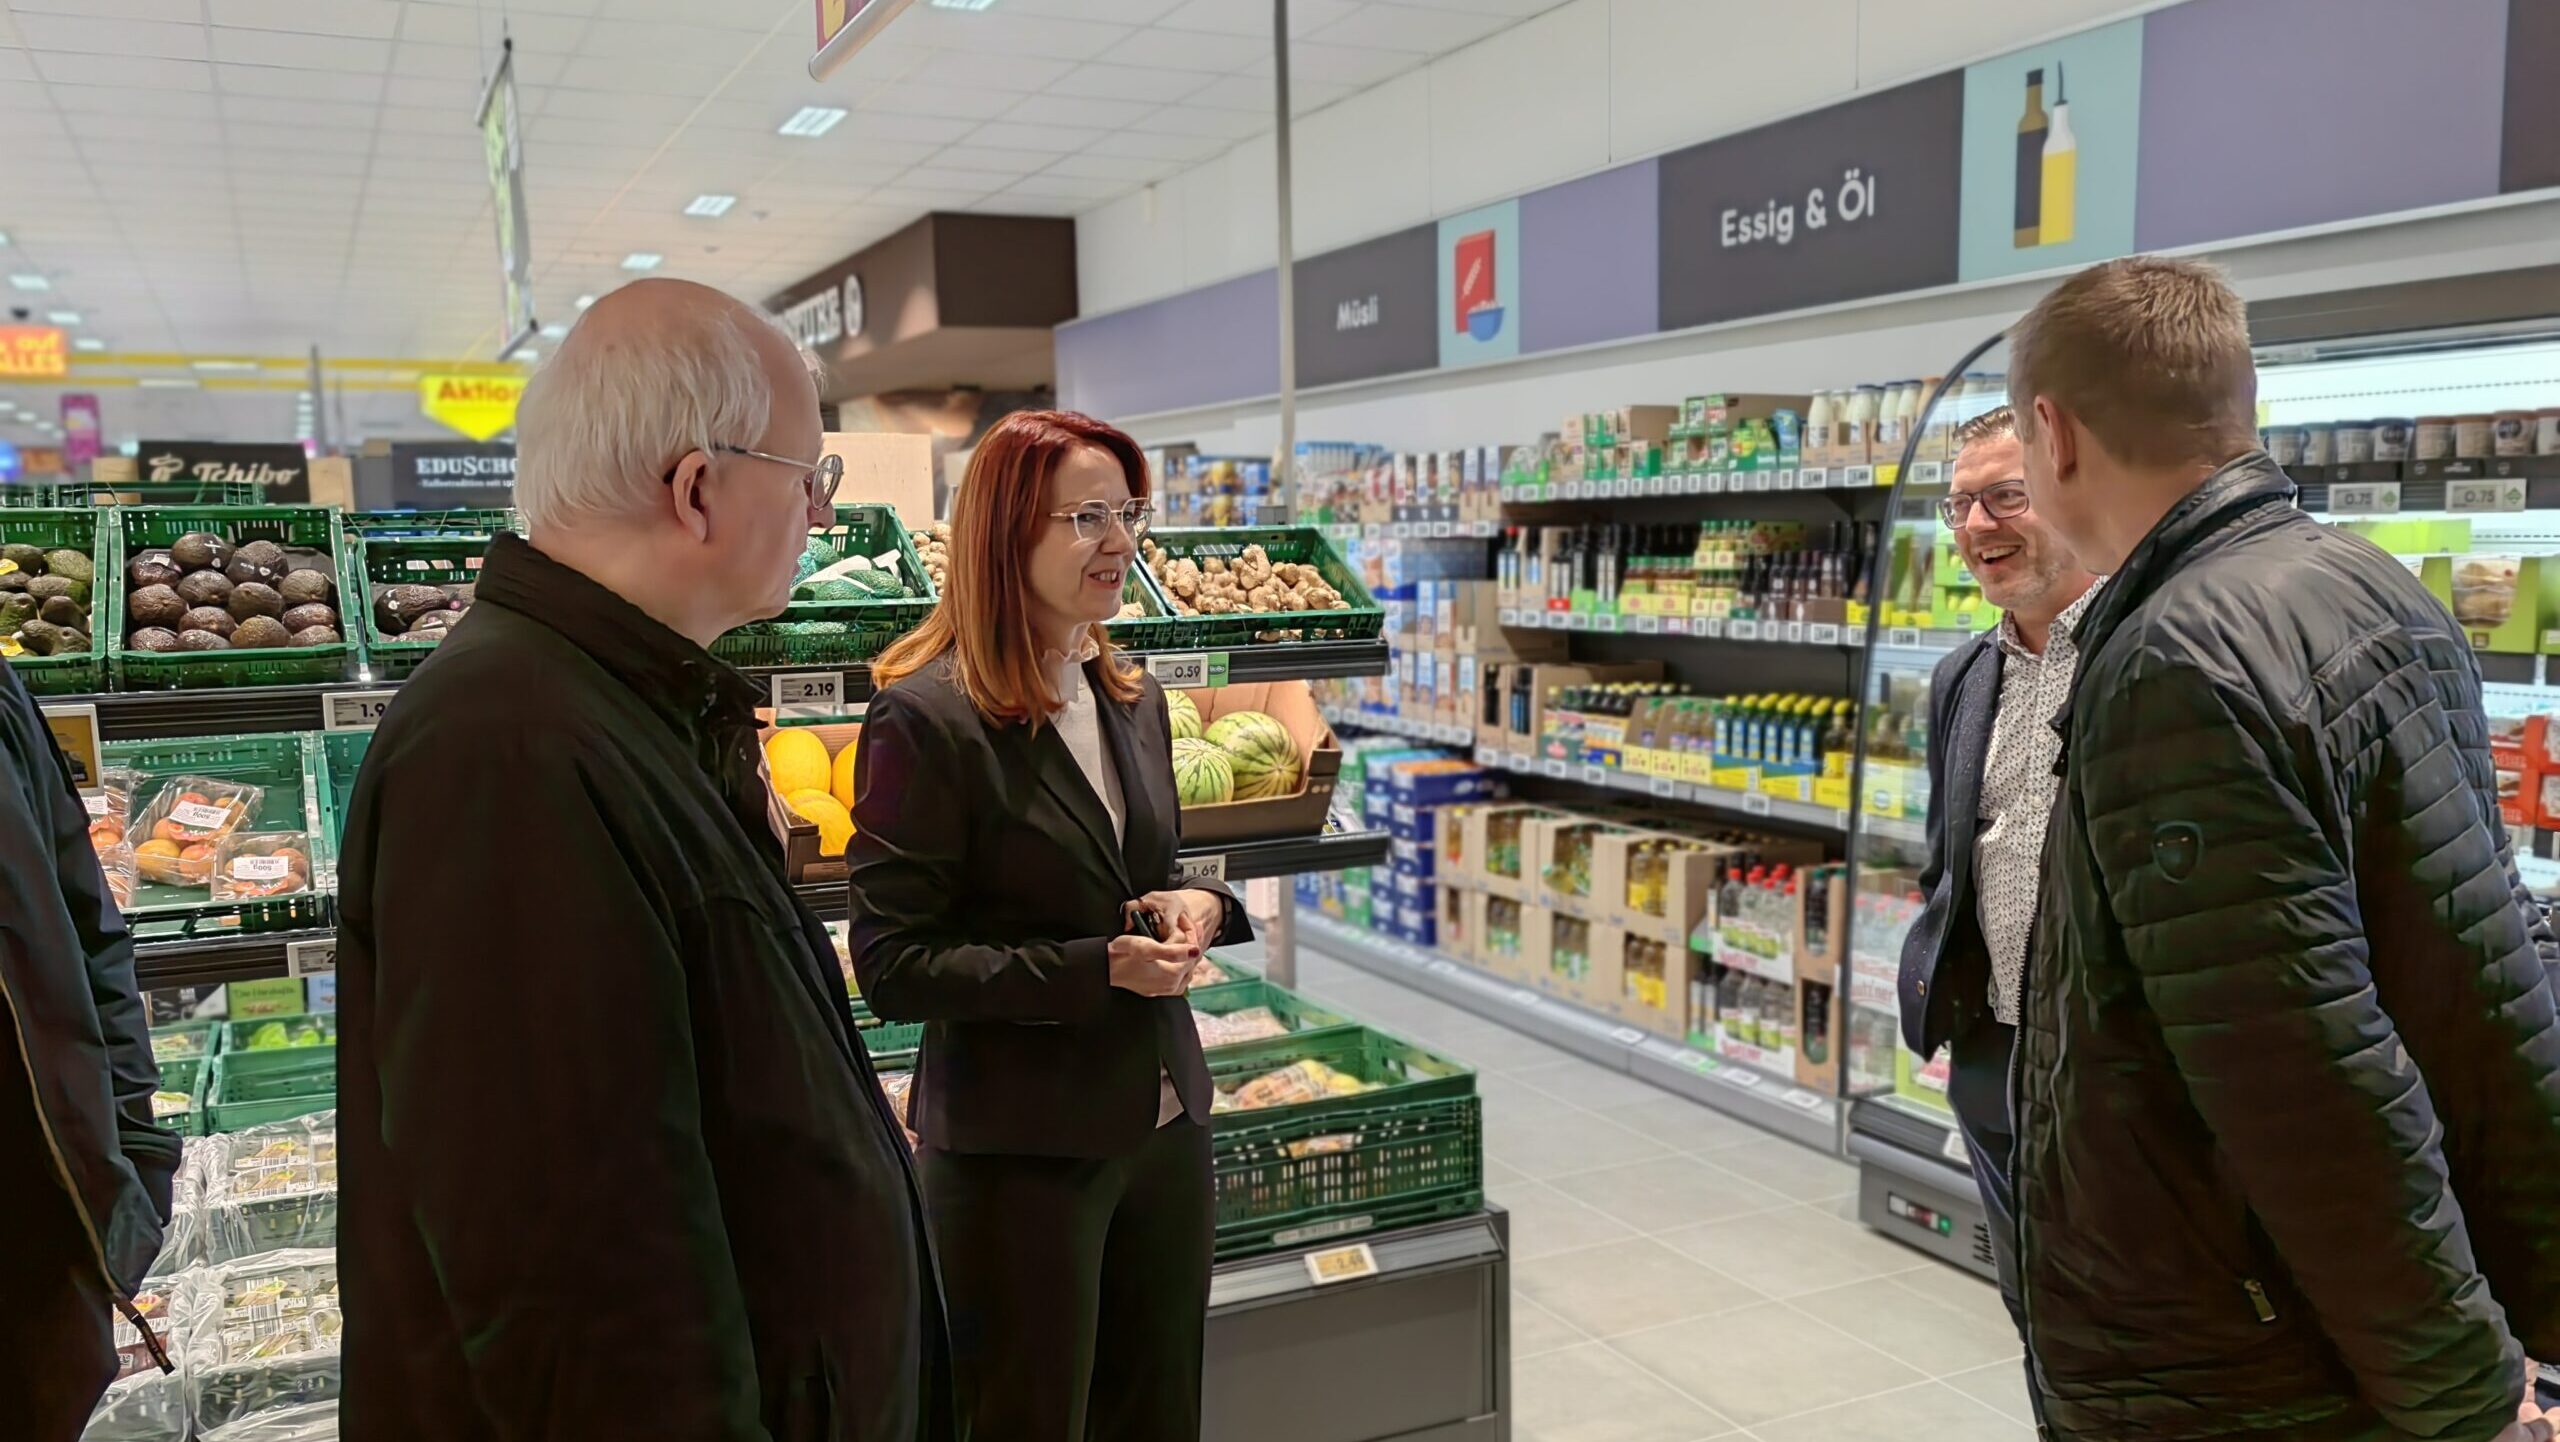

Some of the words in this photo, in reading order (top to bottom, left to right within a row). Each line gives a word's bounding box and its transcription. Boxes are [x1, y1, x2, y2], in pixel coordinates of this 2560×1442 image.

[1721, 199, 1794, 247] Essig
[1806, 187, 1827, 229] &
[1838, 168, 1875, 221] Öl
[1337, 295, 1378, 331] Müsli
[192, 462, 300, 485] Tchibo
[2344, 492, 2374, 505] 0.75
[2464, 489, 2496, 503] 0.75
[1174, 665, 1201, 678] 0.59
[804, 682, 835, 697] 2.19
[360, 702, 386, 717] 1.9
[326, 950, 337, 964] 2
